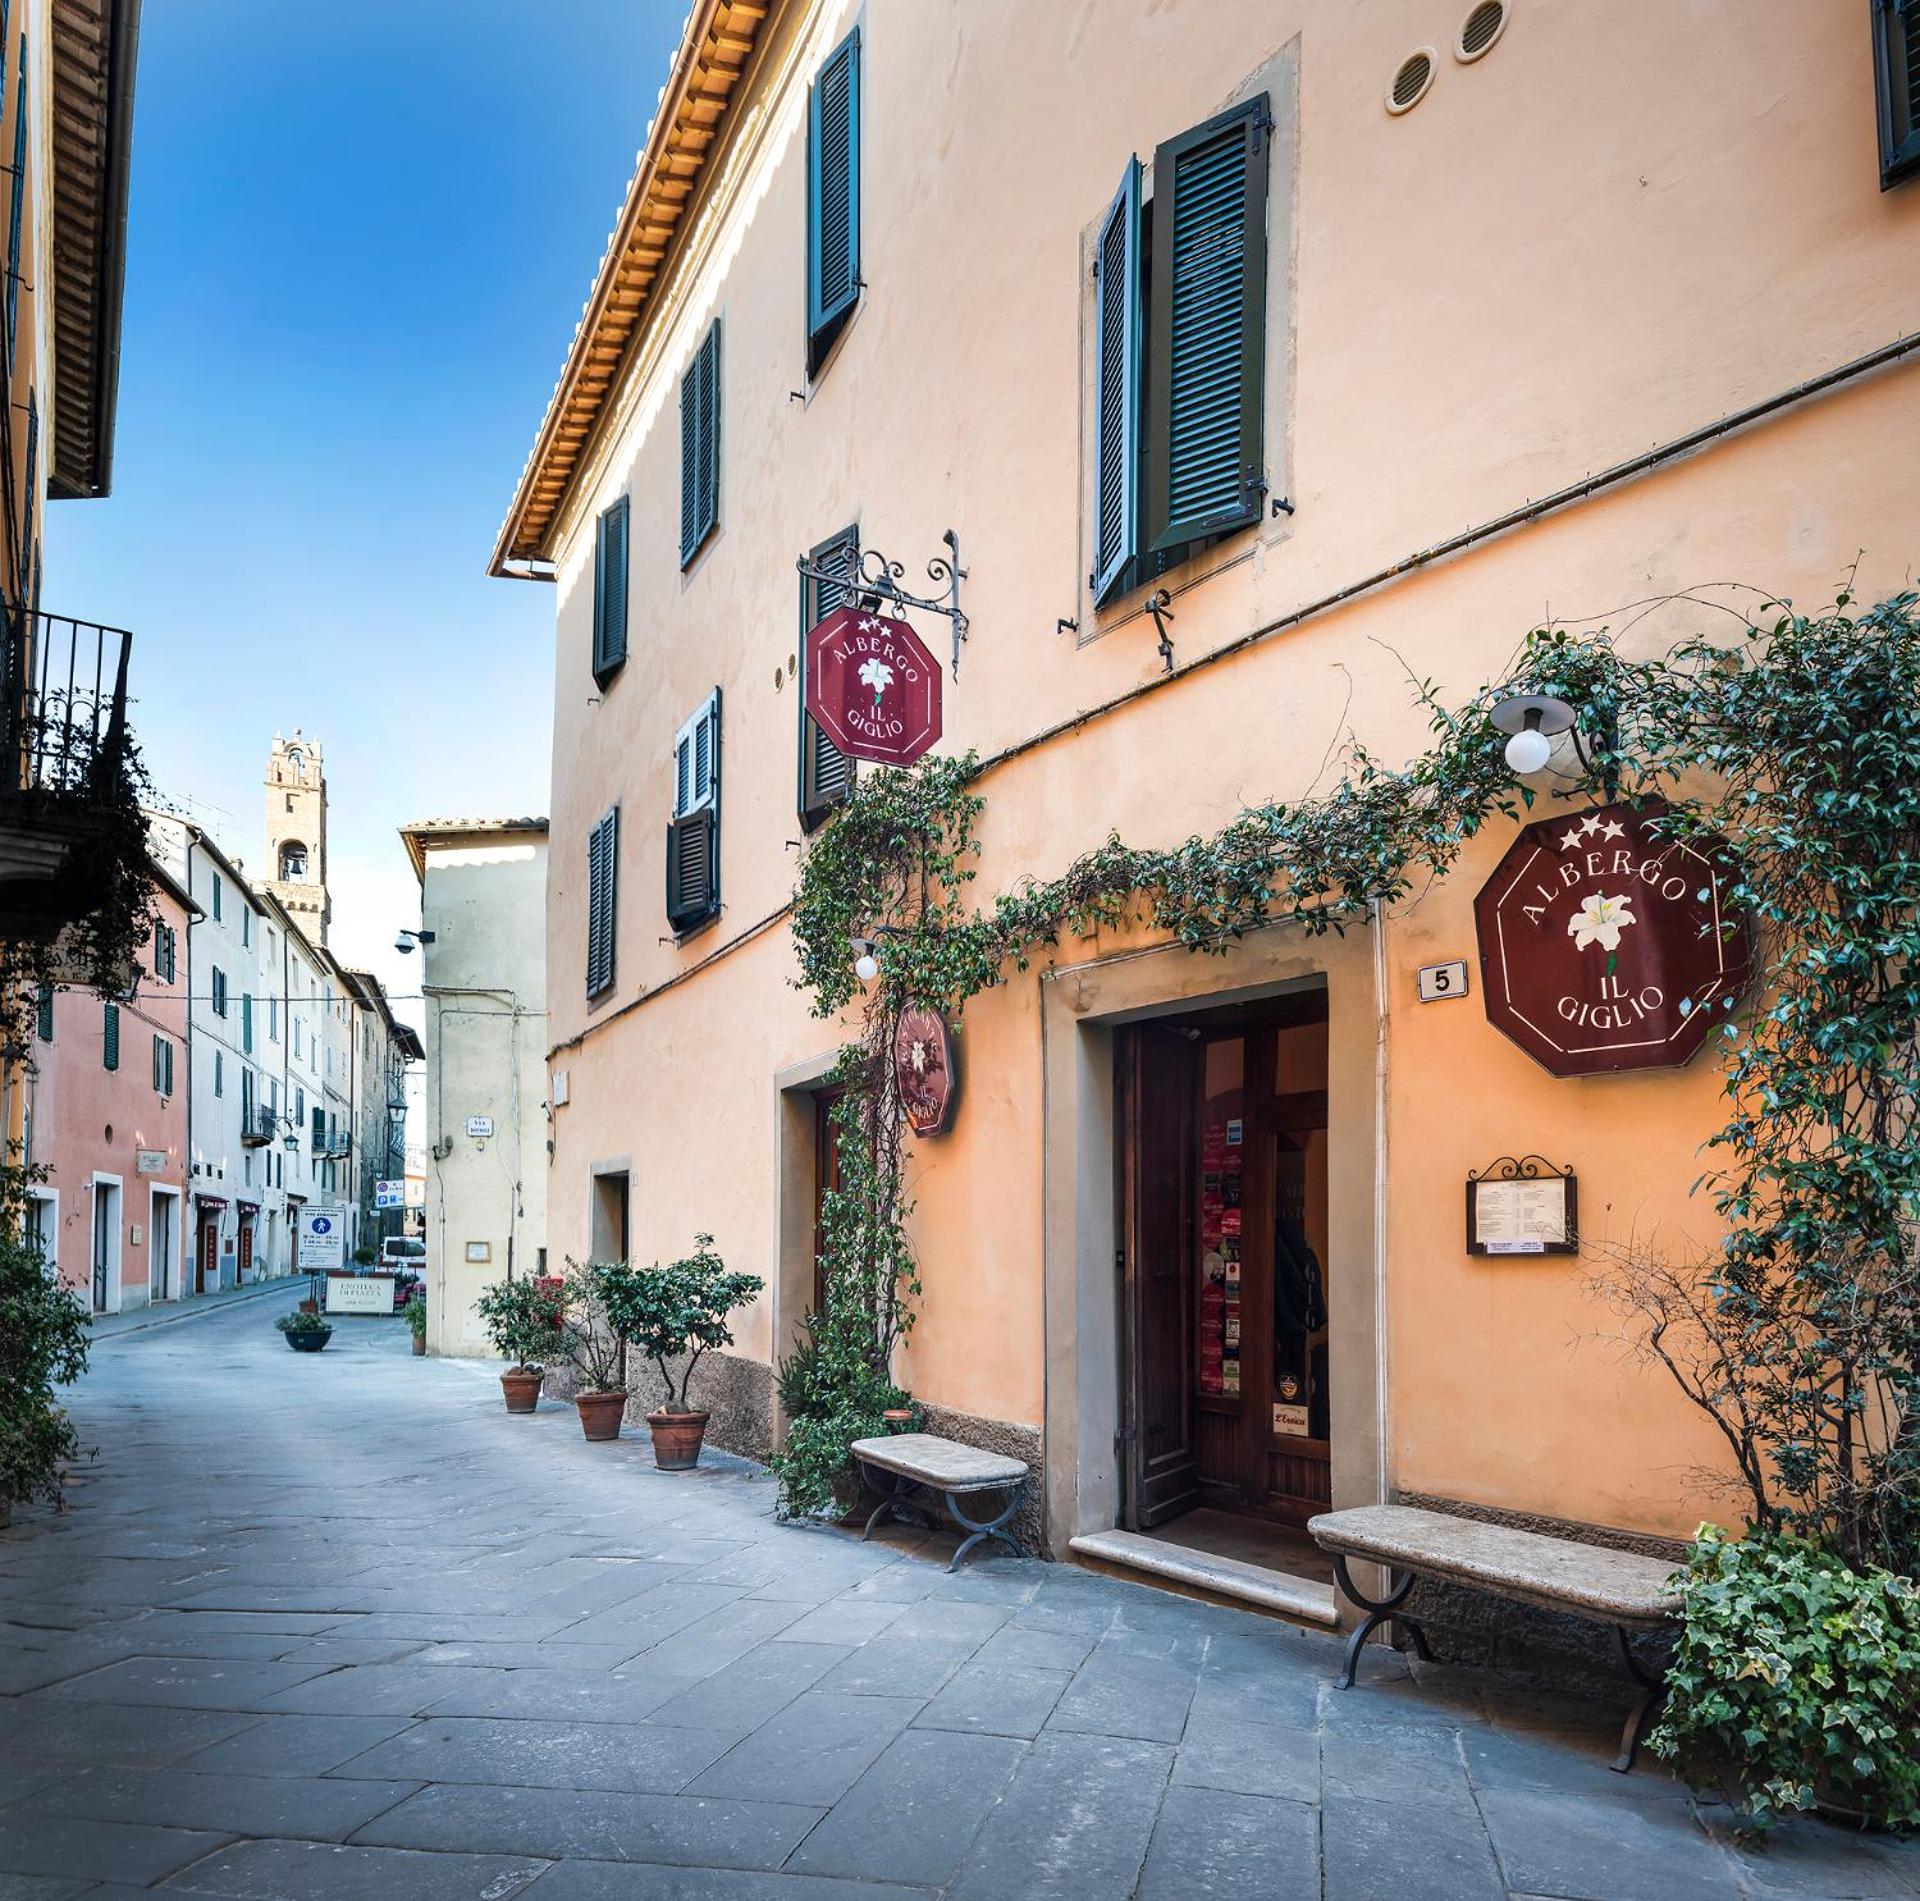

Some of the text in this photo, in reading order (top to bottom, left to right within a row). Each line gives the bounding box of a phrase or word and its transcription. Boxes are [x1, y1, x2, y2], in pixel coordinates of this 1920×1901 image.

[833, 637, 918, 682] ALBERGO
[847, 709, 904, 738] GIGLIO
[870, 705, 886, 722] IL
[1522, 849, 1686, 926] ALBERGO
[1435, 969, 1450, 991] 5
[1600, 975, 1629, 1000] IL
[1556, 986, 1664, 1029] GIGLIO
[919, 1084, 929, 1098] IL
[912, 1096, 938, 1119] GIGLIO
